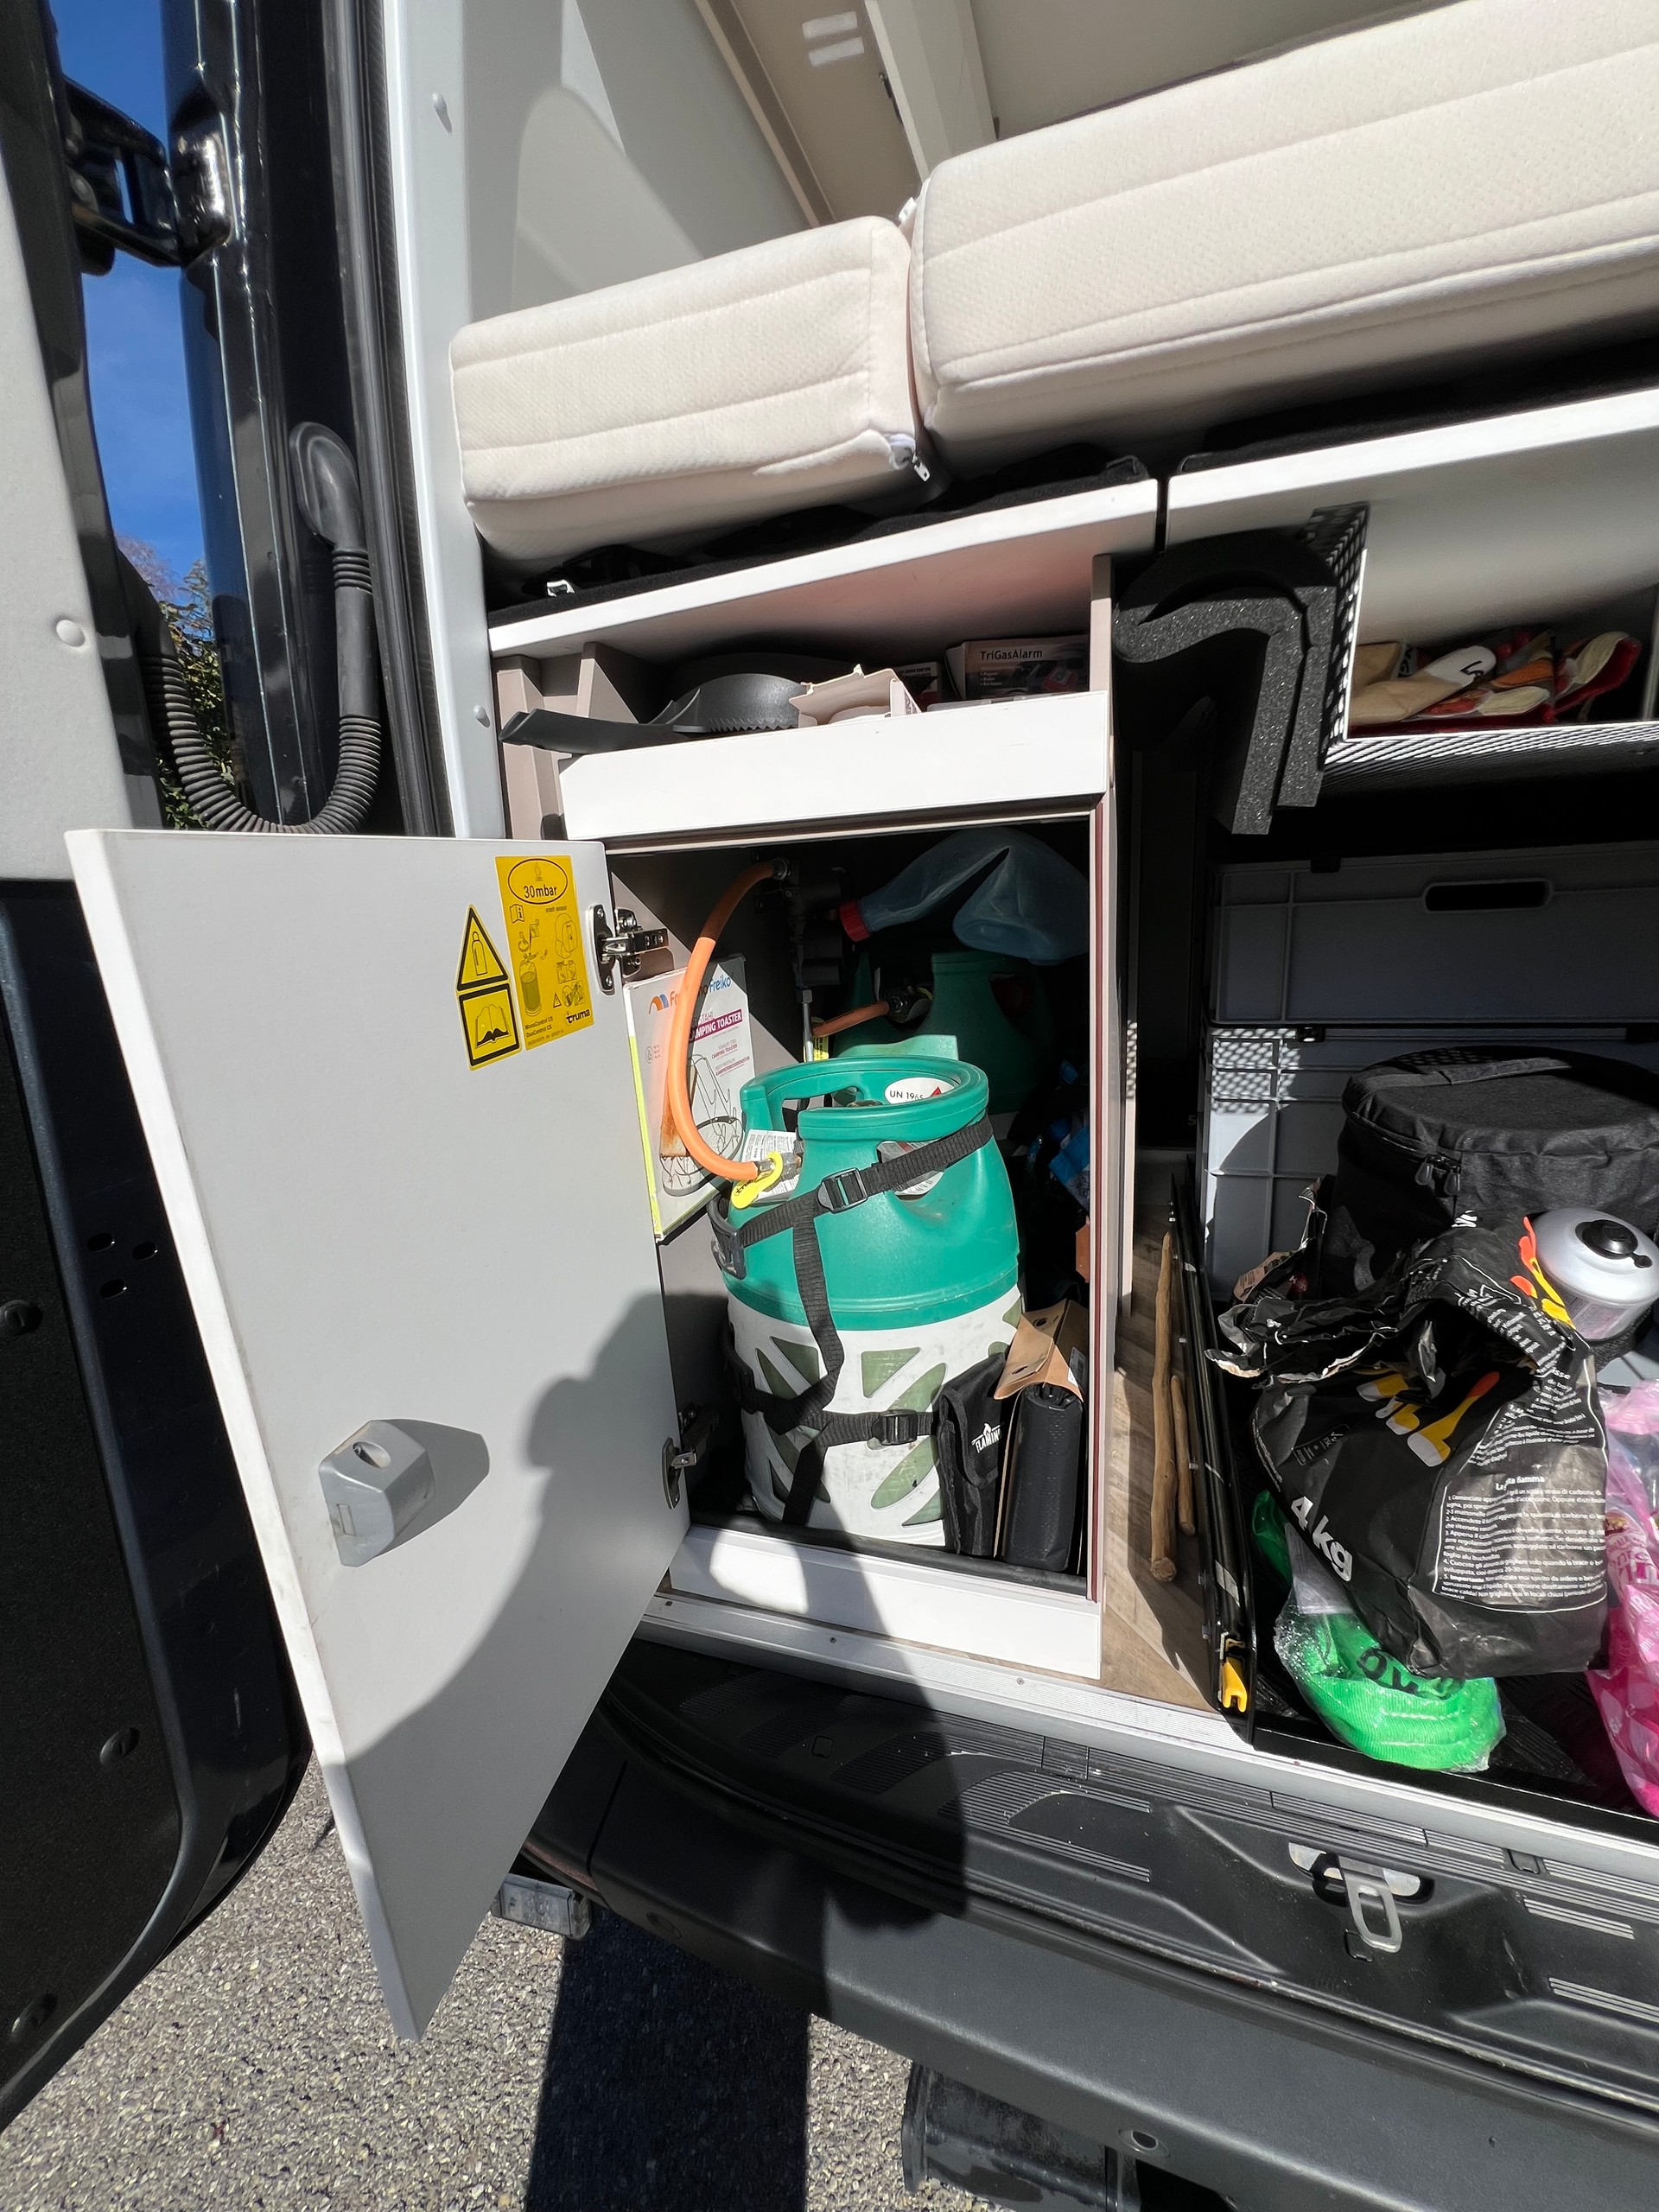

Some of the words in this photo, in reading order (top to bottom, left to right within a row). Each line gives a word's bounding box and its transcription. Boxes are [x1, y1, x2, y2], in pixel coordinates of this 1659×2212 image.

[980, 649, 1043, 661] TriGasAlarm
[566, 1009, 590, 1024] truma
[716, 1012, 742, 1029] TOASTER
[889, 1090, 903, 1099] UN
[1451, 1516, 1482, 1524] Accendete
[1290, 1496, 1313, 1532] 4
[1312, 1514, 1353, 1582] kg
[1443, 1550, 1461, 1559] foglio
[1449, 1559, 1475, 1567] Cuocete
[1542, 1559, 1567, 1567] quando
[1441, 1585, 1459, 1593] brace
